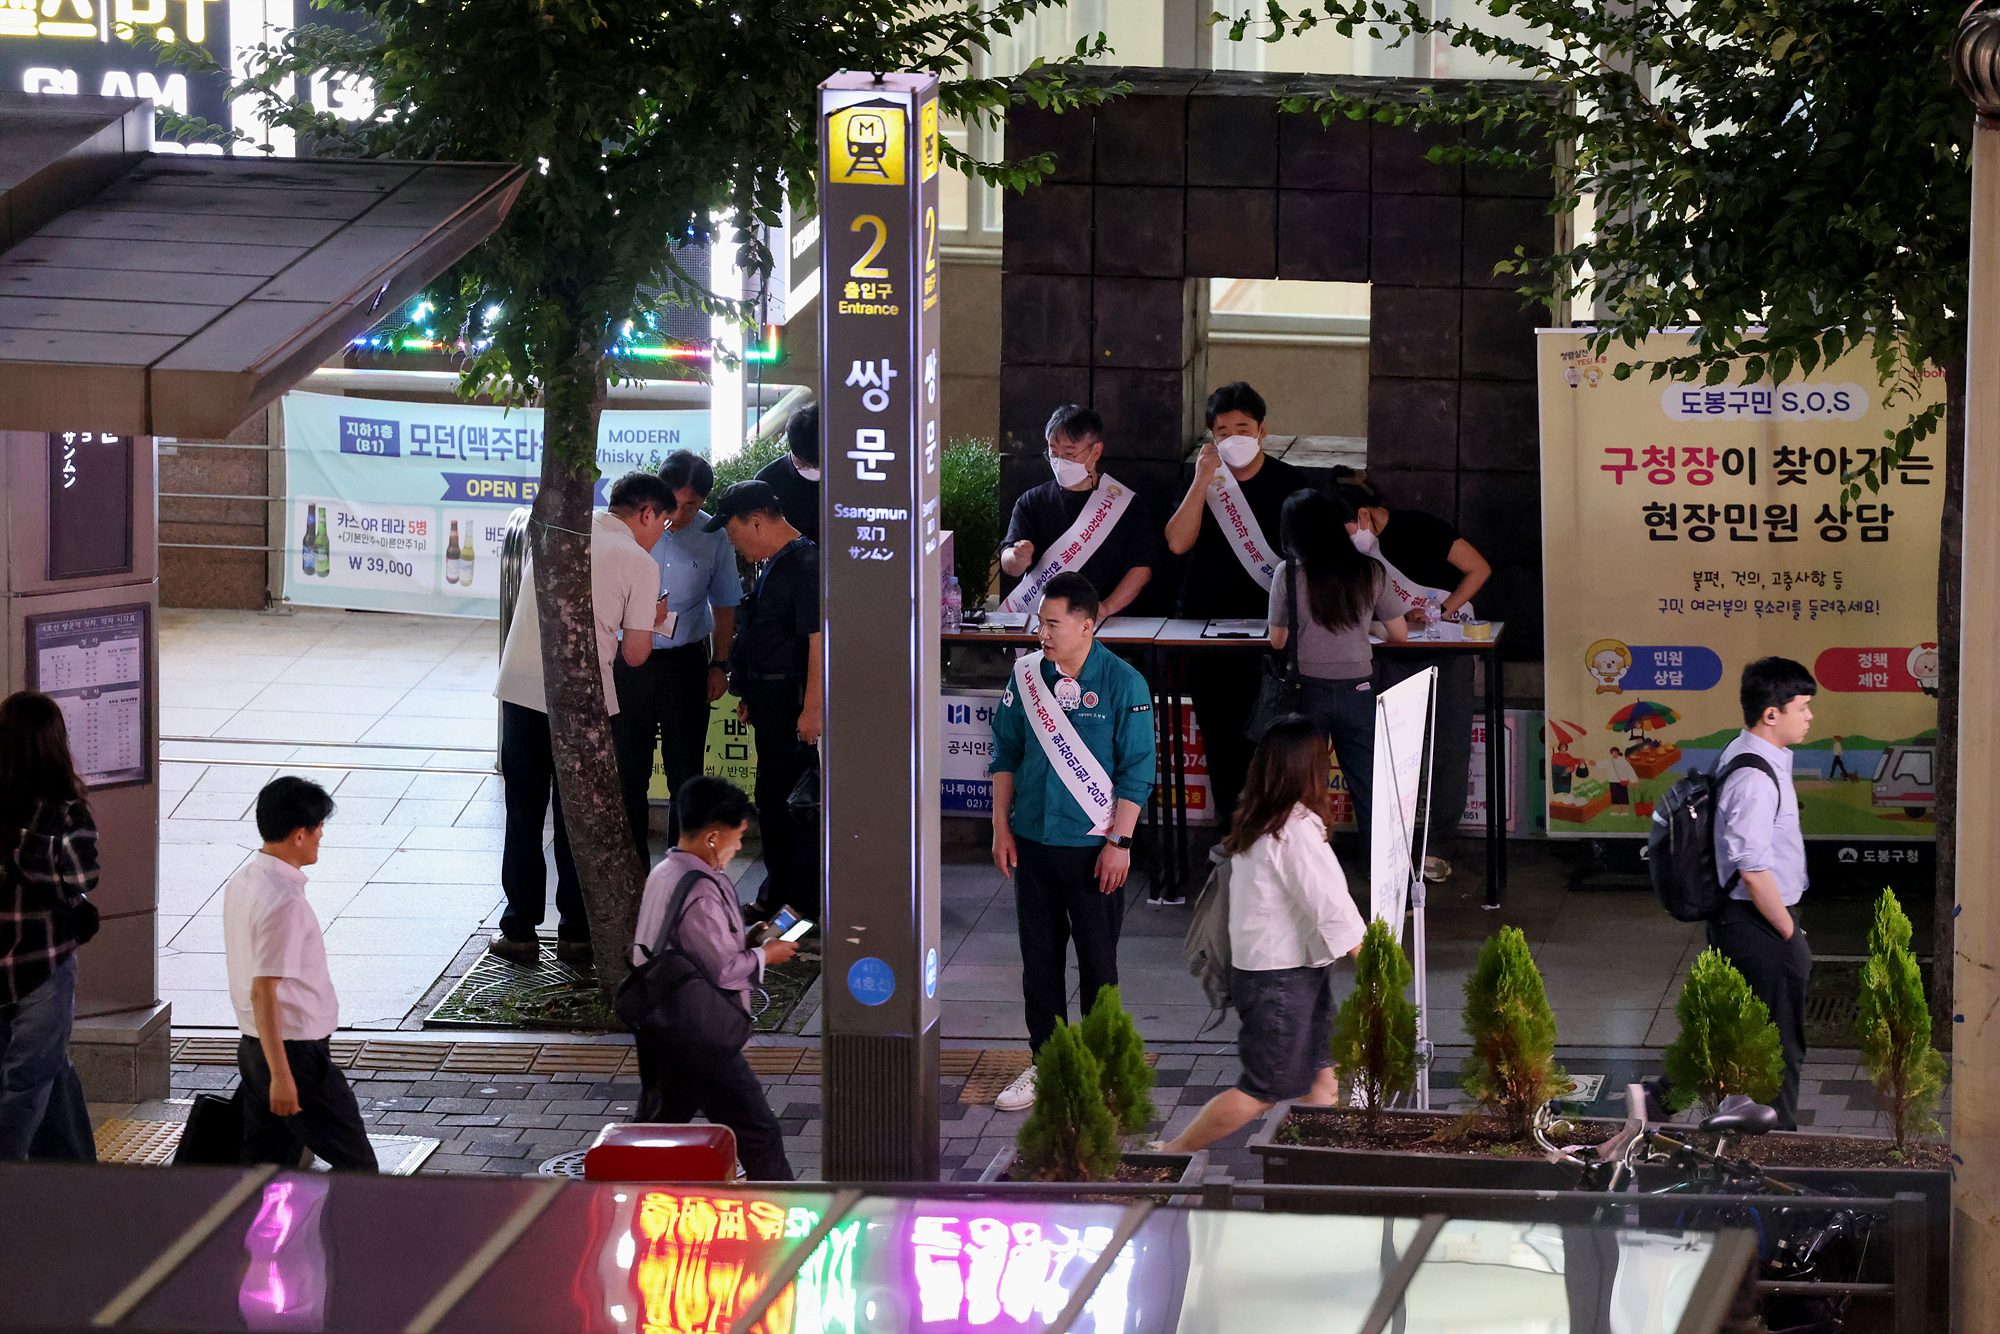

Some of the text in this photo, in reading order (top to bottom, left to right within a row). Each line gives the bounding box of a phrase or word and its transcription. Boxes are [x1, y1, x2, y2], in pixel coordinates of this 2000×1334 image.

[850, 214, 889, 278] 2
[925, 206, 936, 273] 2
[843, 281, 893, 299] 출입구
[838, 301, 899, 316] Entrance
[1680, 391, 1851, 415] 도봉구민 S.O.S
[845, 358, 897, 481] 쌍문
[346, 421, 394, 439] 지하1층
[608, 429, 680, 444] MODERN
[355, 438, 385, 455] (B1)
[62, 431, 77, 489] サンムン
[650, 450, 661, 463] &
[1600, 444, 1934, 486] 구청장이 찾아가는
[466, 479, 517, 498] OPEN
[834, 503, 908, 522] Ssangmun
[1079, 500, 1113, 543] 구청장과
[1642, 501, 1895, 542] 현장민원 상담
[337, 512, 427, 536] 카스 OR 테라 5병
[1219, 491, 1249, 539] 구청장과
[1243, 540, 1265, 563] 함께
[856, 526, 886, 542] 双门
[848, 547, 894, 561] サンムン
[1060, 541, 1083, 565] 함께
[367, 557, 413, 577] 39,000
[1693, 571, 1843, 591] 불편, 건의, 고충사항 등
[1658, 598, 1880, 621] 구민 여러분의 목소리를 들려주세요!
[1653, 650, 1683, 667] 민원
[1857, 652, 1888, 669] 정책
[1653, 669, 1684, 686] 상담
[1857, 670, 1889, 688] 제안
[1024, 670, 1108, 807] 도봉구청장 현장민원 상담
[1862, 850, 1919, 863] 도봉구청
